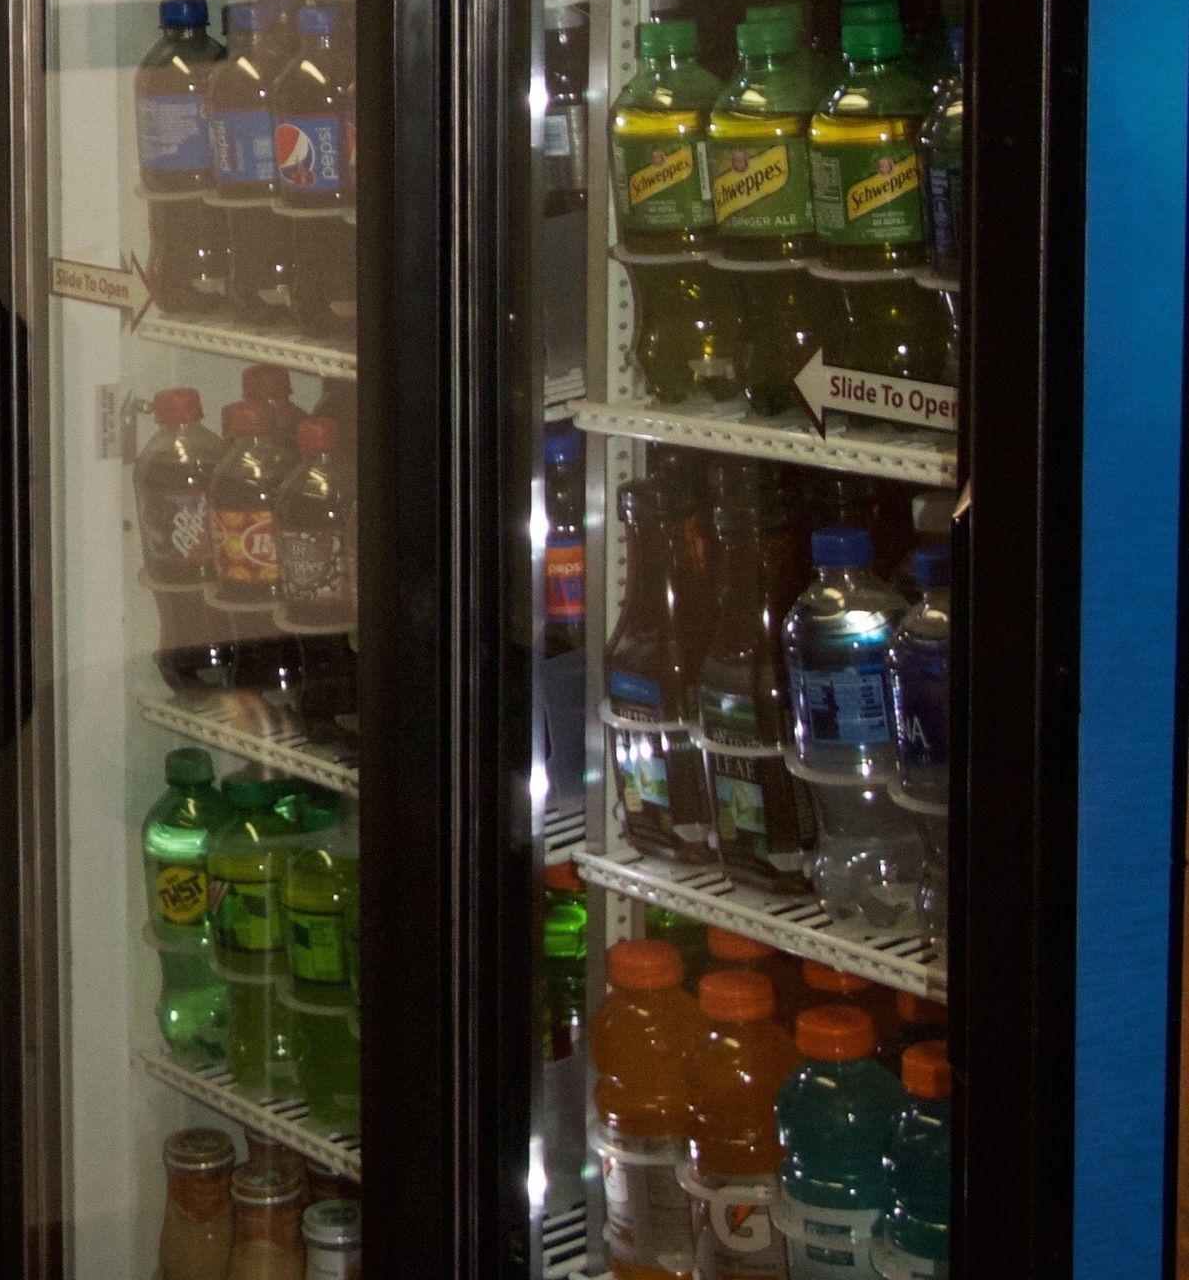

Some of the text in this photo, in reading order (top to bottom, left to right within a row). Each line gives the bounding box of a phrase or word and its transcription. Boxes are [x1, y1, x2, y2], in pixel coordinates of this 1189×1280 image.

[315, 126, 339, 180] pepsi
[632, 158, 691, 198] Schweppes
[55, 268, 129, 300] Slide To Open
[829, 375, 877, 403] Slide
[881, 383, 904, 408] To
